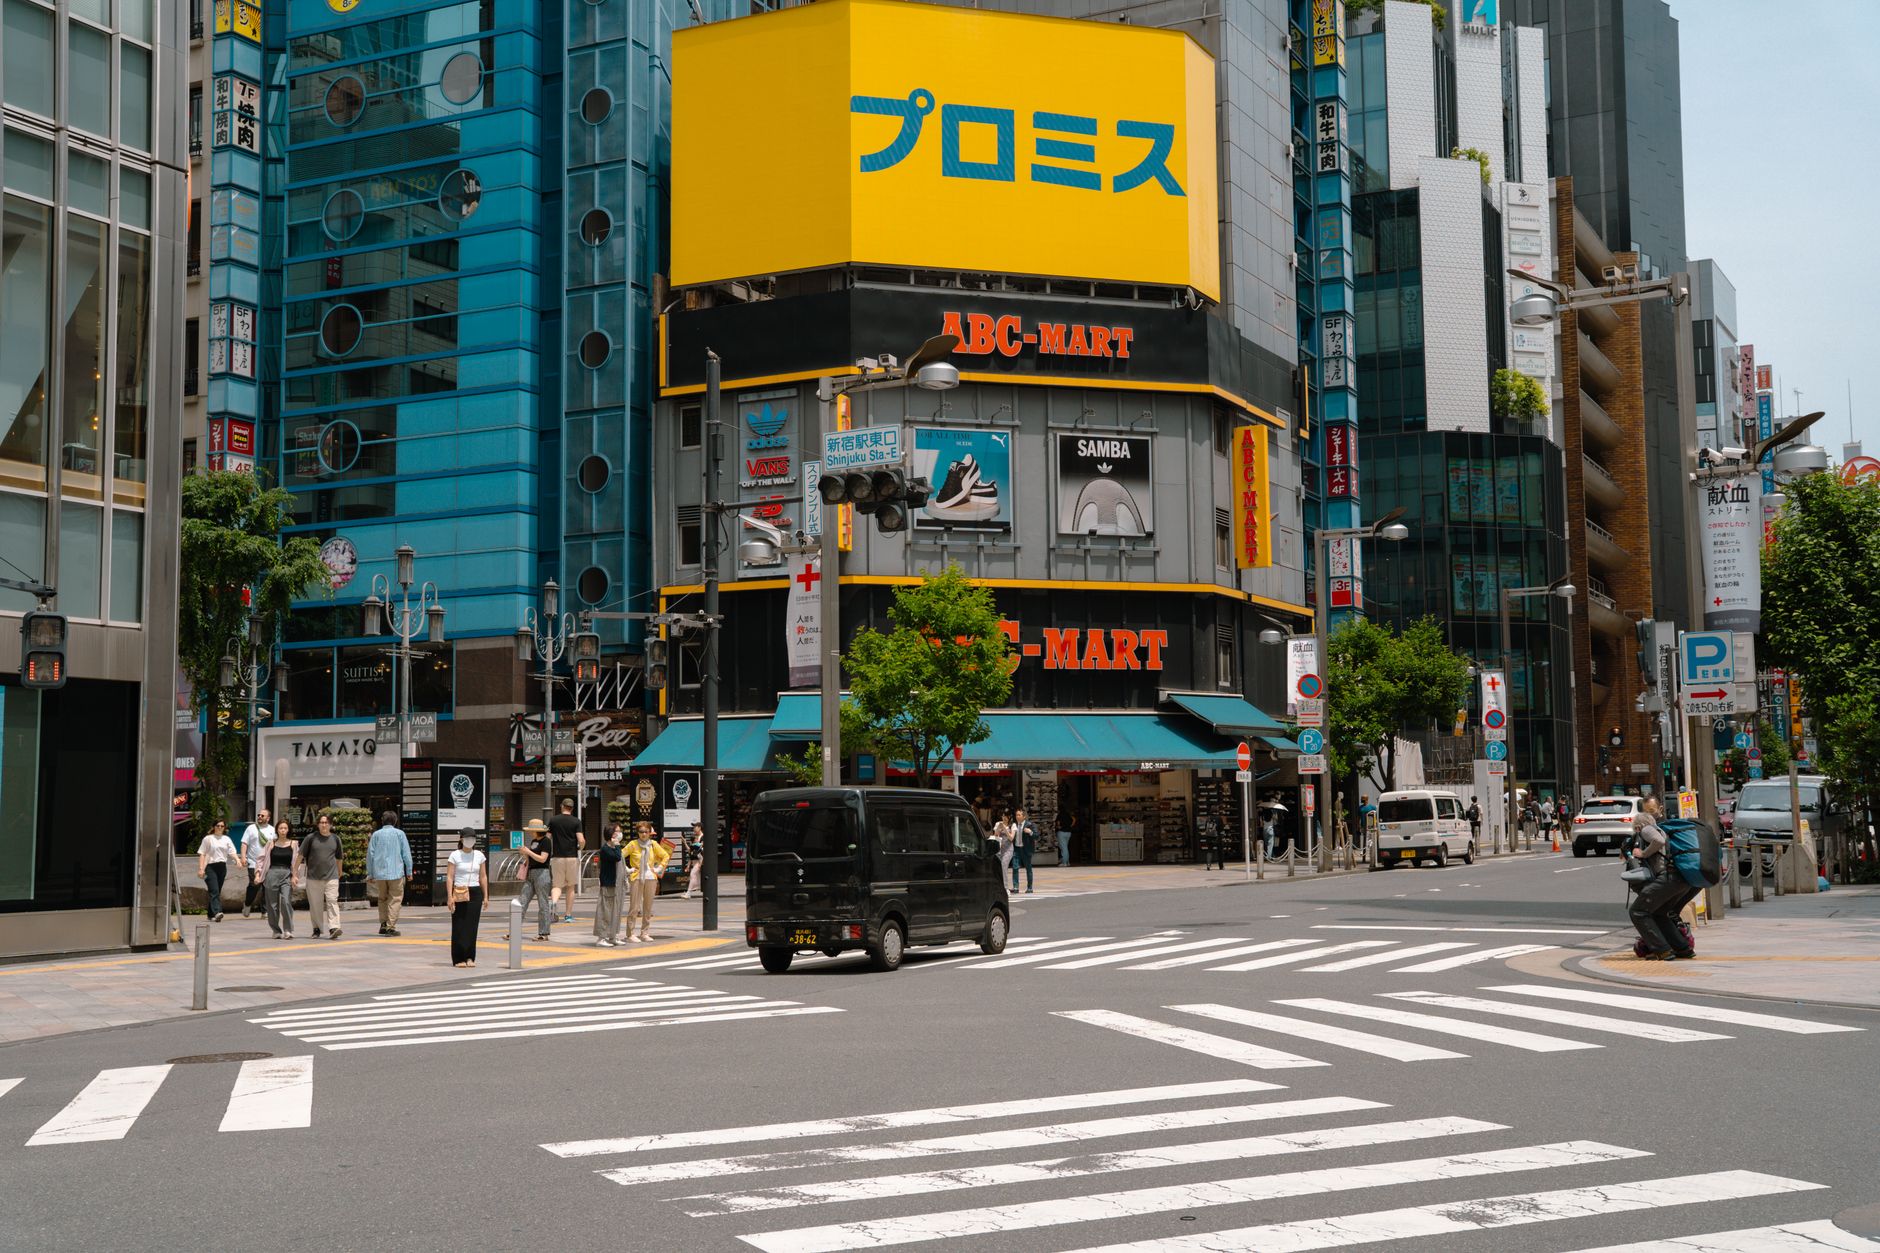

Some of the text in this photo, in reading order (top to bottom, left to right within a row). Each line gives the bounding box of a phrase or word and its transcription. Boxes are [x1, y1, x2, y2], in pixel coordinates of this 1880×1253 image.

[1463, 25, 1498, 37] HULIC
[238, 81, 256, 99] 7F
[216, 79, 228, 145] 和牛焼肉
[237, 102, 255, 150] 焼肉
[850, 87, 1187, 198] プロミス
[1319, 104, 1336, 171] 和牛焼肉
[214, 304, 226, 316] 5F
[236, 306, 248, 317] 5F
[1326, 318, 1342, 328] 5F
[942, 311, 1134, 359] ABC-MART
[827, 430, 897, 453] 新宿駅東口
[953, 432, 972, 440] TIME
[746, 436, 790, 450] adidas
[1077, 439, 1131, 459] SAMBA
[827, 452, 866, 466] Shinjuku
[1332, 428, 1346, 483] シェーキーズ
[746, 456, 790, 477] VANS
[758, 478, 774, 486] THE
[1332, 485, 1345, 494] 4F
[1707, 484, 1750, 506] 献血
[807, 464, 819, 533] スクランブル式
[1242, 430, 1258, 565] ABC-MART
[1708, 506, 1750, 516] ストリート
[1336, 580, 1350, 591] 3F
[917, 620, 1168, 675] C-MART
[1292, 644, 1313, 652] 献血
[1686, 636, 1727, 680] P
[1701, 668, 1730, 678] 駐車場
[1686, 702, 1734, 714] この先50m右折
[378, 717, 396, 726] モア
[412, 716, 434, 726] MOA
[554, 731, 570, 739] モア
[577, 716, 632, 748] Bee
[1303, 734, 1314, 750] P
[1490, 745, 1499, 758] P
[175, 757, 195, 768] ONES
[978, 762, 1008, 770] ABC-MART
[1140, 762, 1170, 770] ABC-MART
